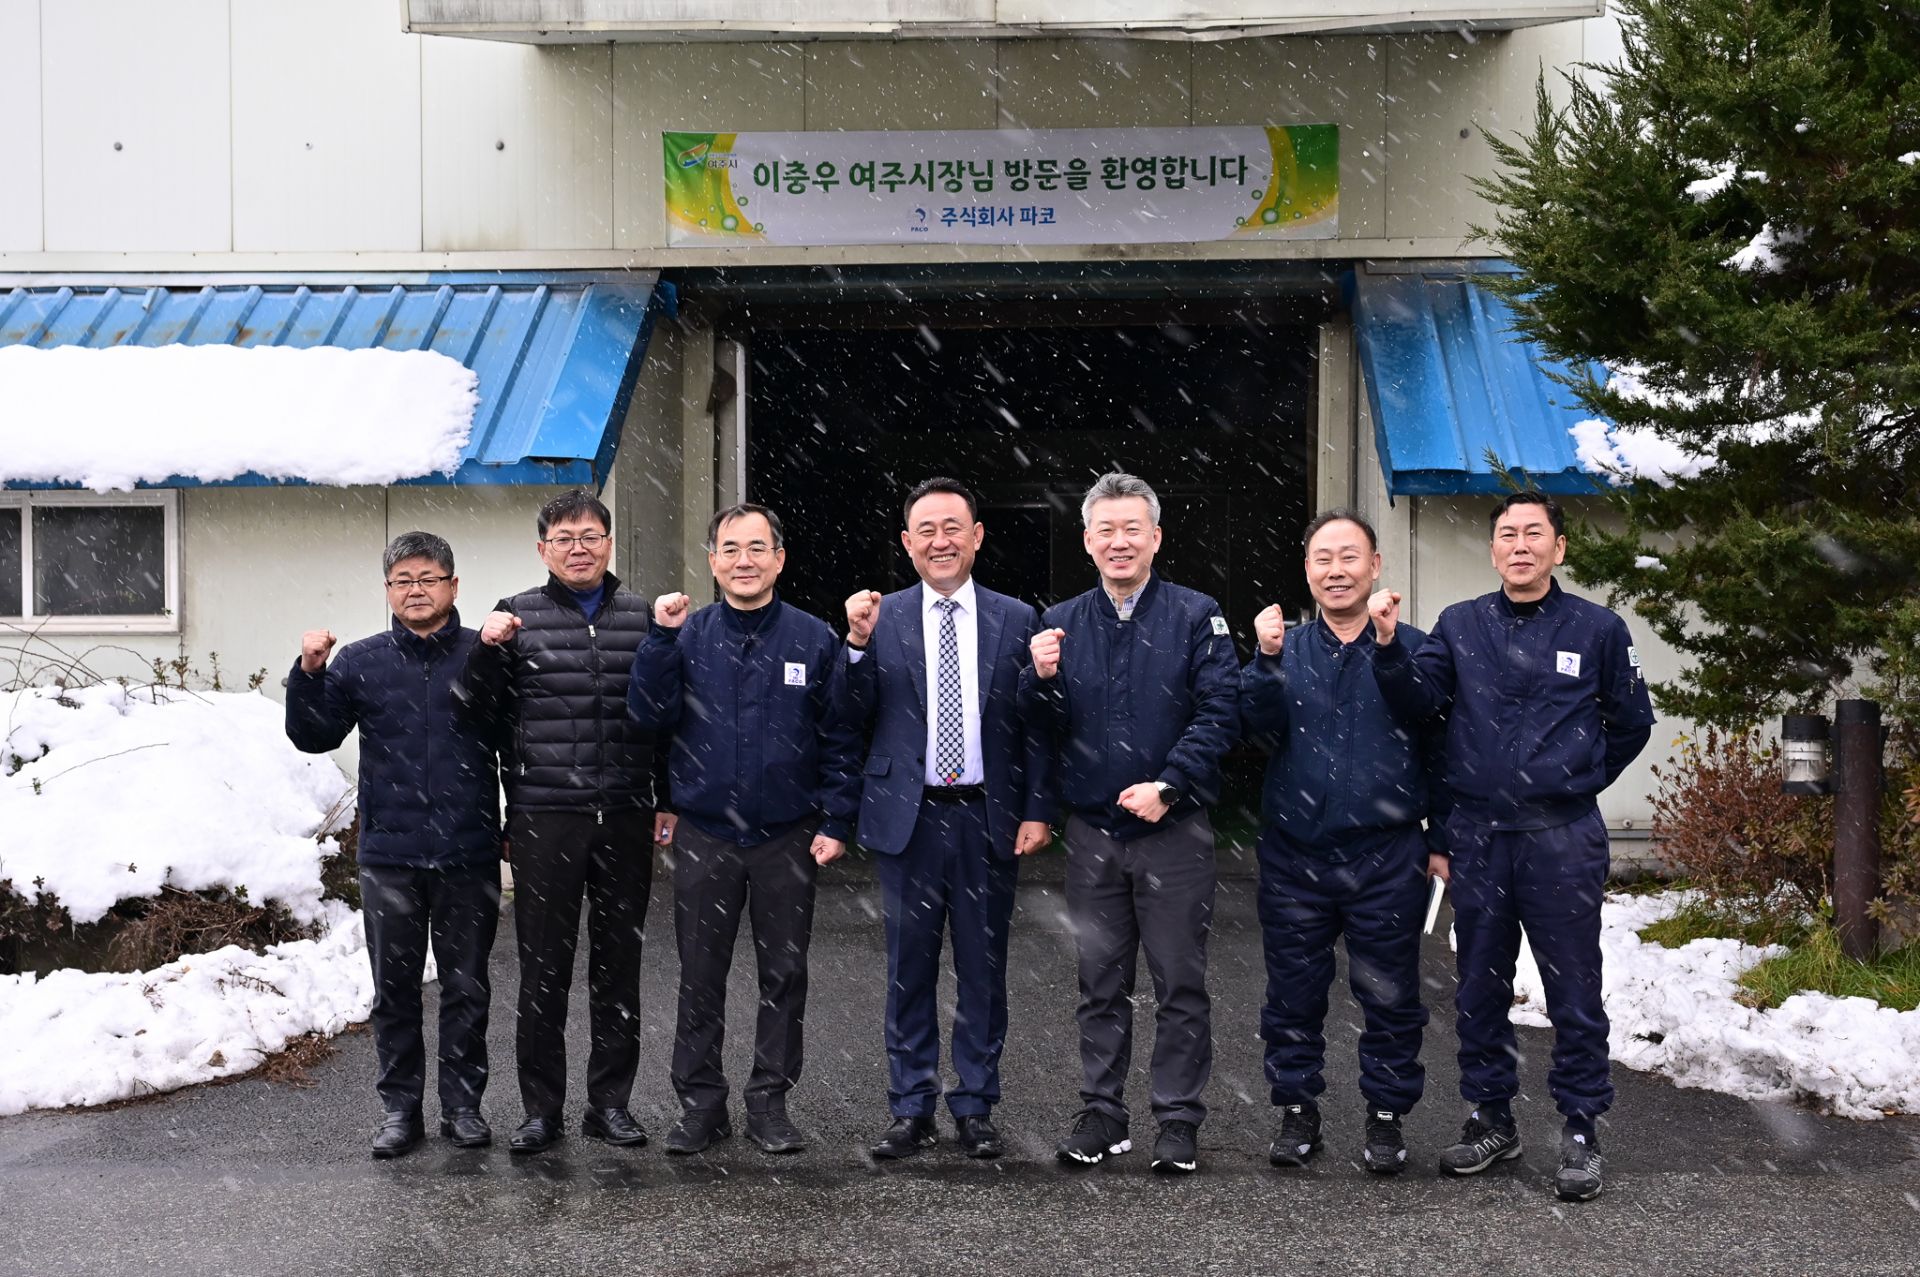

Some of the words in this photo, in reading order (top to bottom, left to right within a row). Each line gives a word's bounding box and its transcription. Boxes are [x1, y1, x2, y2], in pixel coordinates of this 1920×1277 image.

[708, 160, 738, 169] 여주시
[753, 160, 840, 194] 이충우
[849, 160, 993, 193] 여주시장님
[1004, 157, 1091, 192] 방문을
[1100, 155, 1248, 192] 환영합니다
[940, 206, 1015, 228] 주식회사
[1019, 206, 1057, 226] 파코
